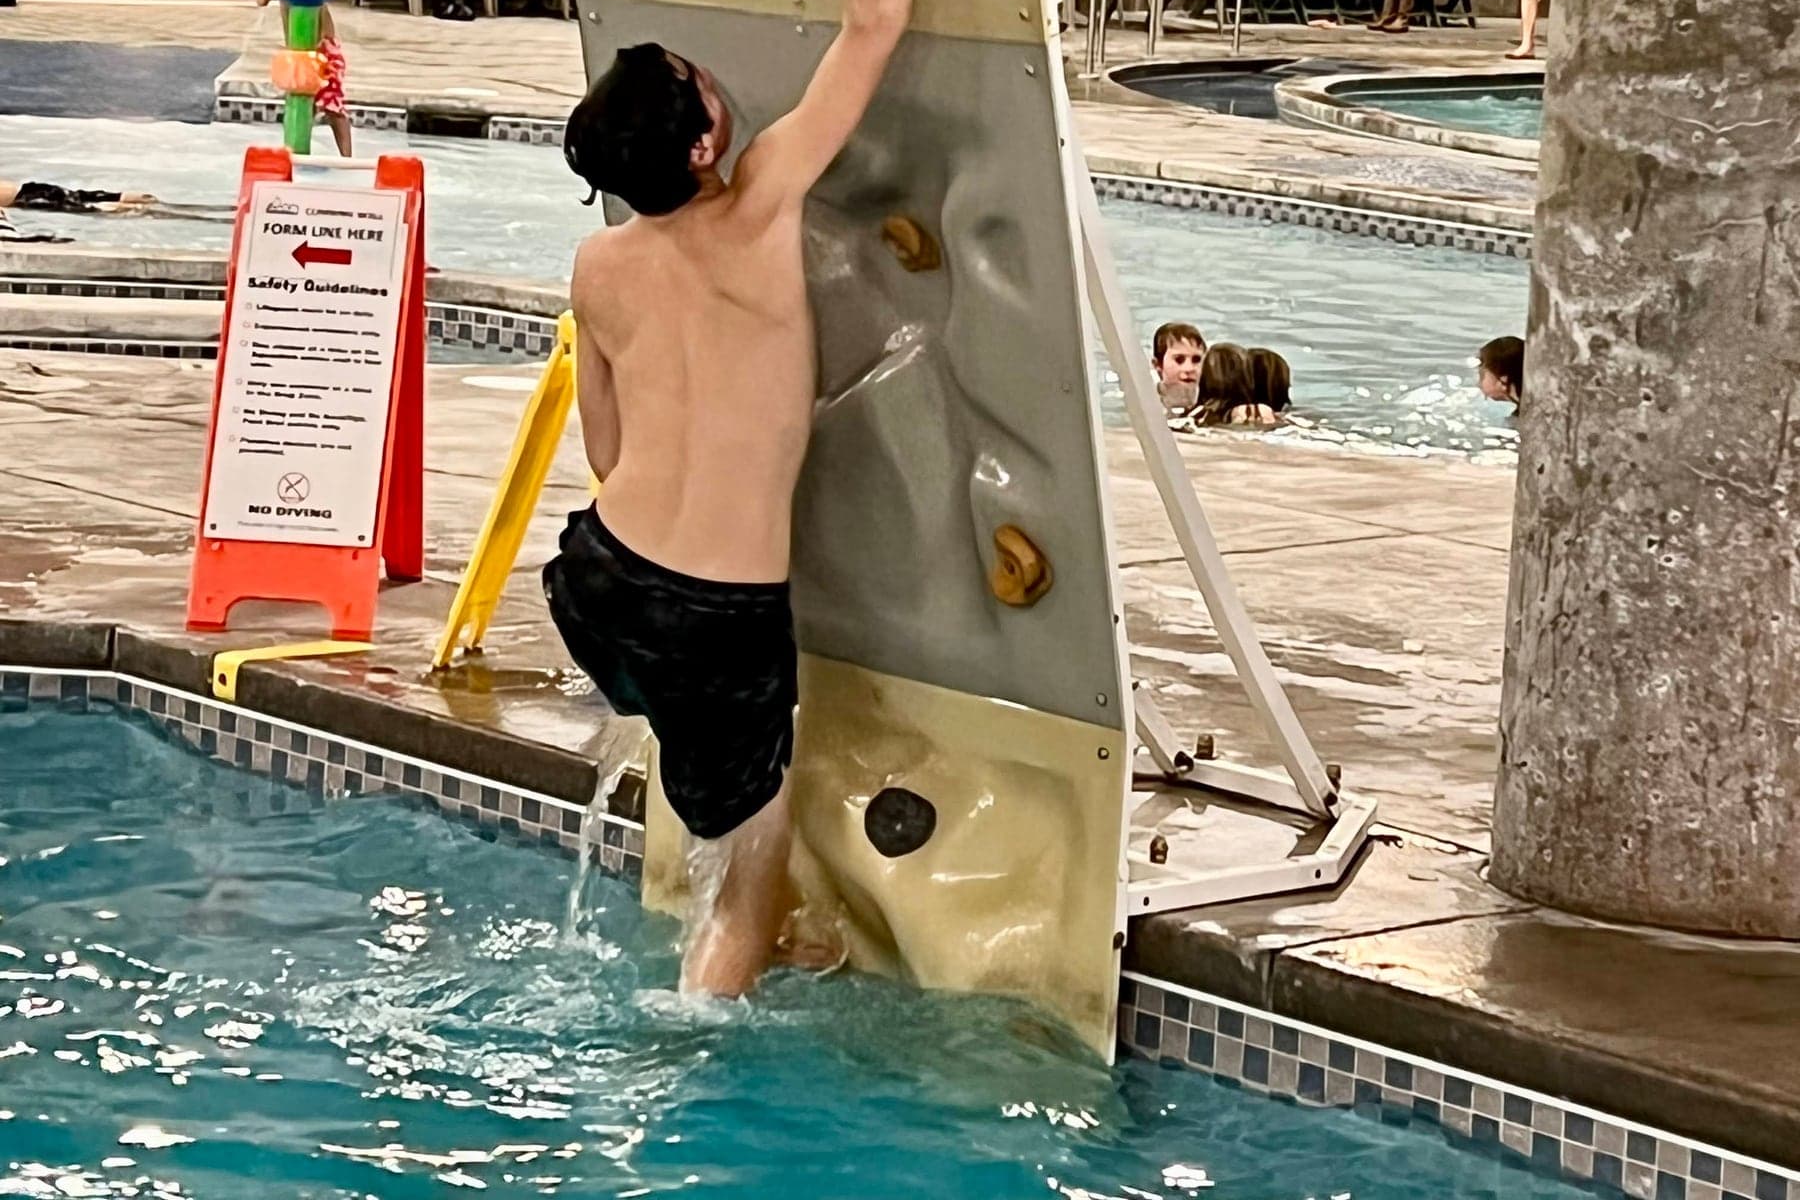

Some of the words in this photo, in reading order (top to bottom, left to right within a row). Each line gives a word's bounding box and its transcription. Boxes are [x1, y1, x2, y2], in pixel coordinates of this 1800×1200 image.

[263, 223, 307, 236] FORM
[311, 226, 342, 239] LINE
[347, 228, 384, 242] HERE
[248, 277, 298, 294] Safety
[304, 279, 388, 297] Guidelines
[248, 505, 272, 515] NO
[275, 506, 333, 519] DIVING
